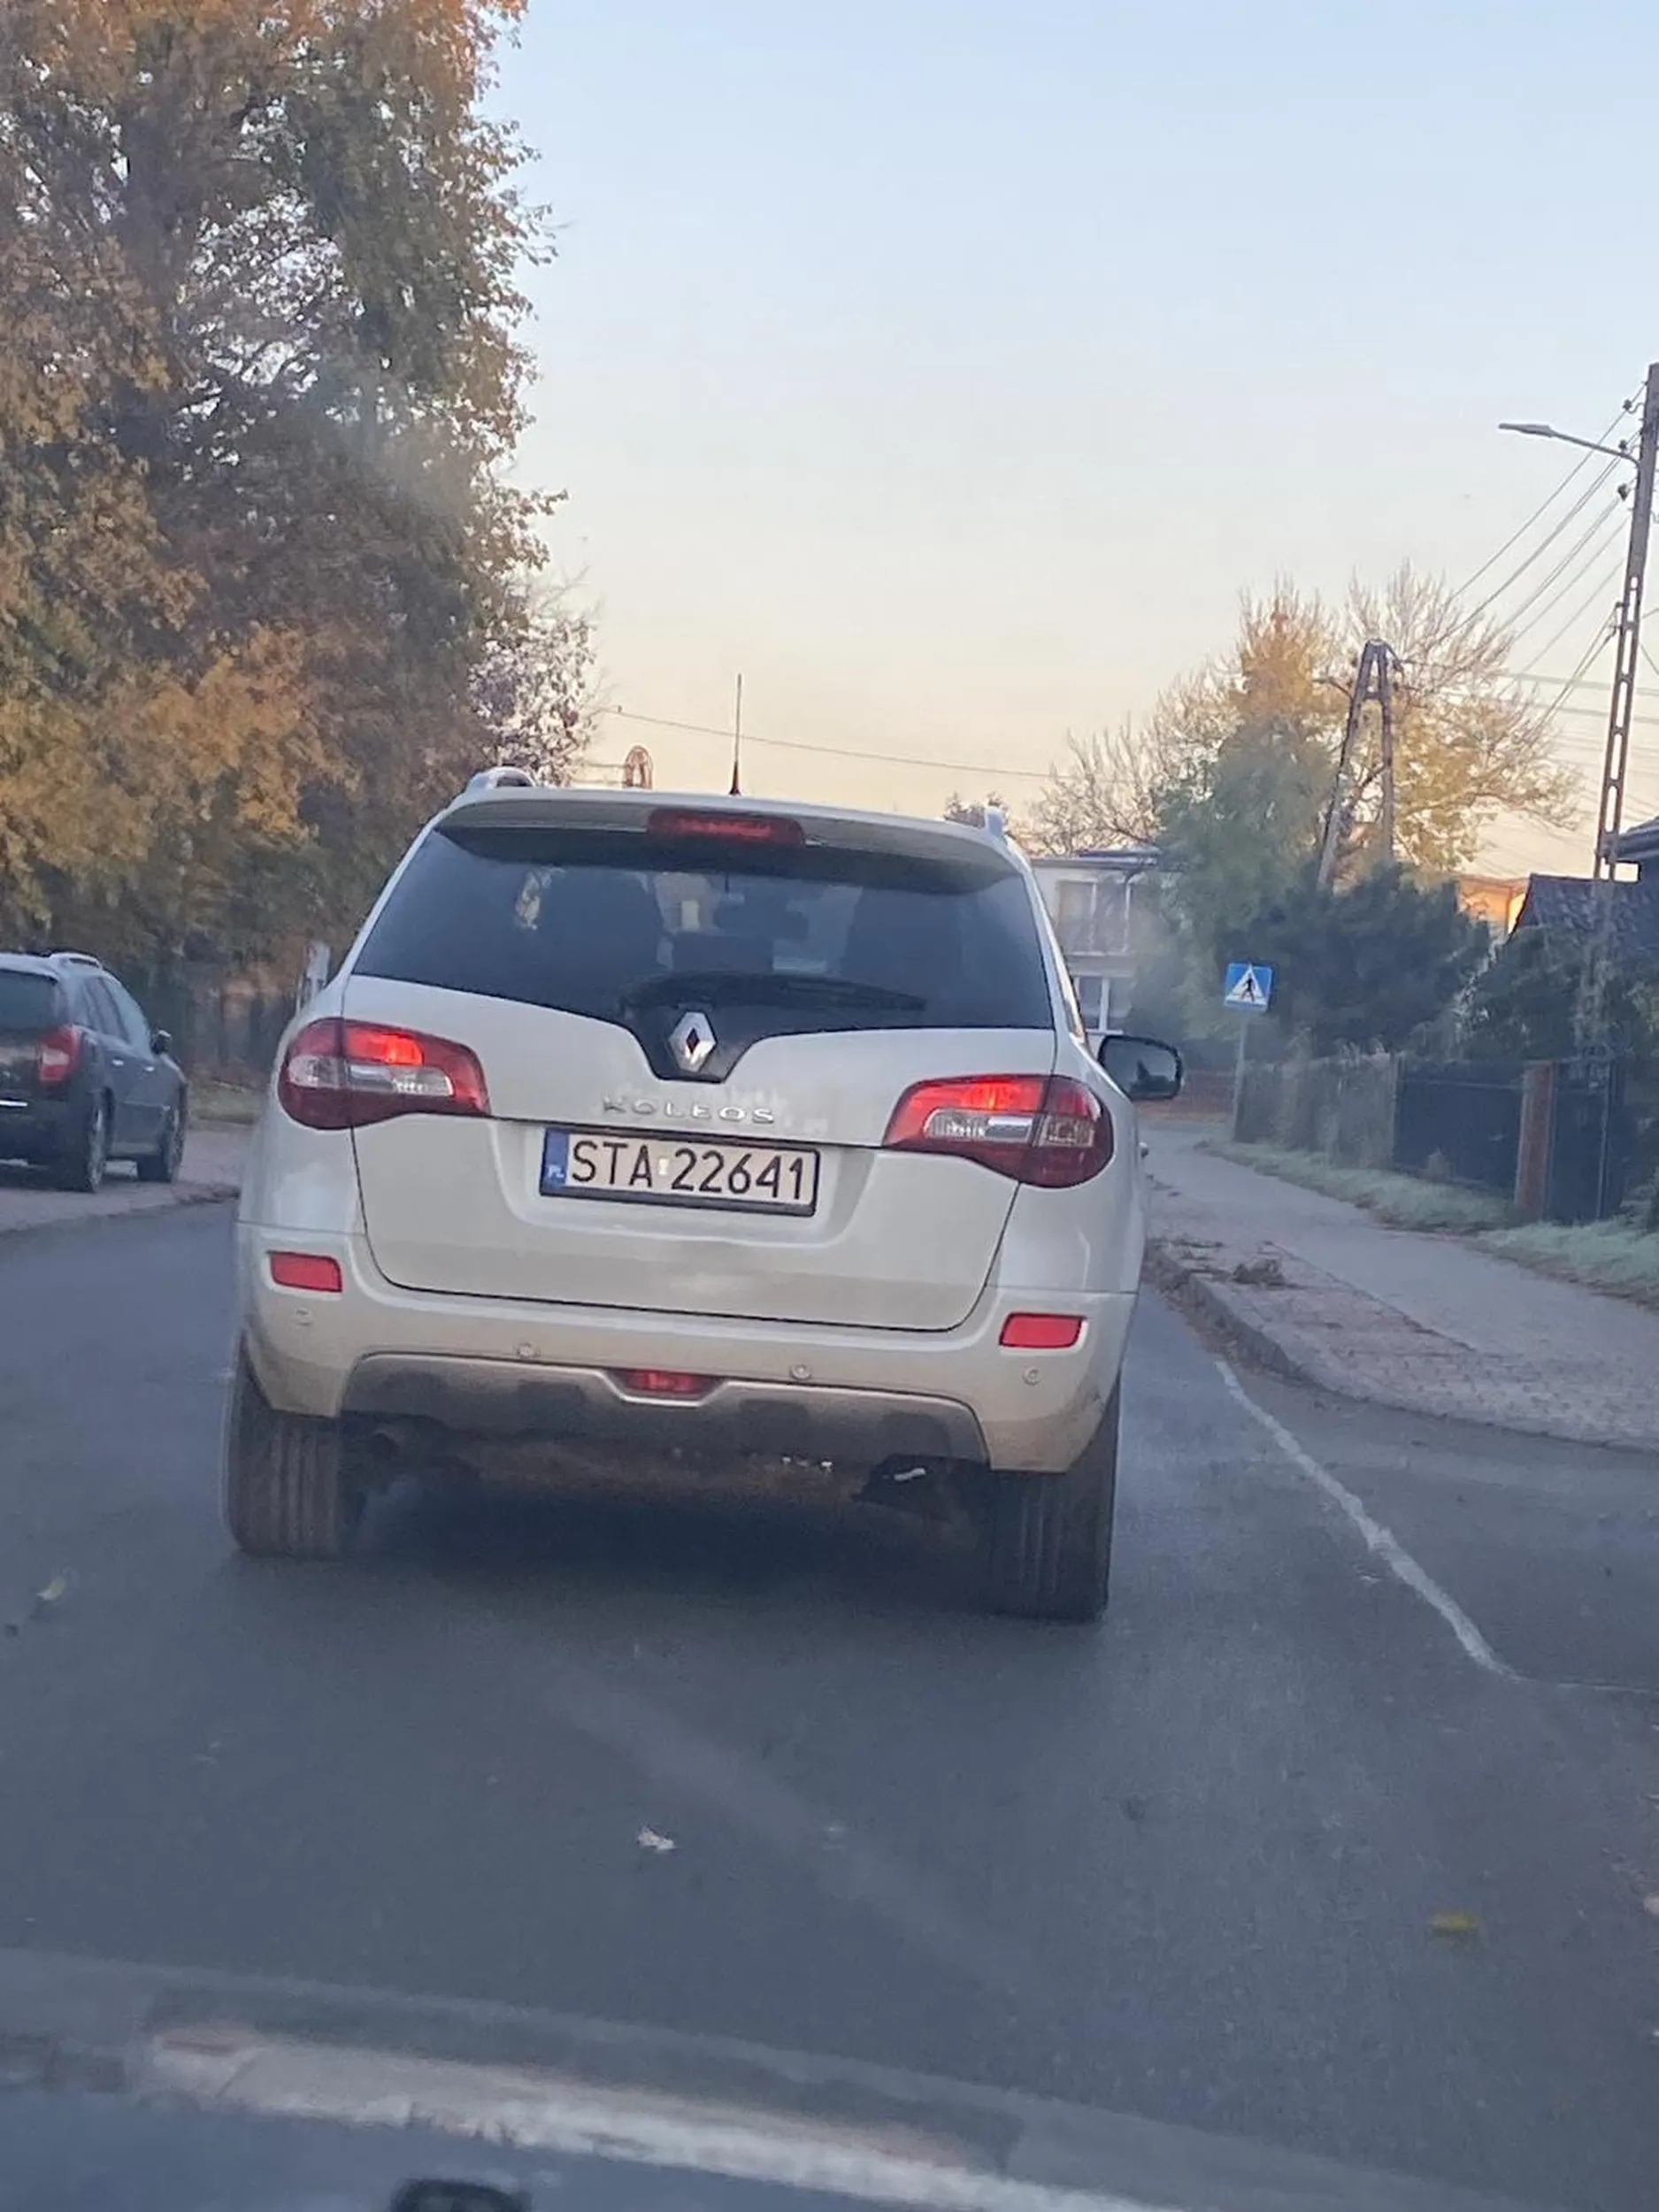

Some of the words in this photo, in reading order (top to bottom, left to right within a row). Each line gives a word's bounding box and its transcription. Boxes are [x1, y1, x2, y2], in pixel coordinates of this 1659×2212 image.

[603, 1094, 775, 1125] KOLEOS
[548, 1165, 565, 1179] PL
[572, 1141, 653, 1187] STA
[671, 1148, 803, 1200] 22641
